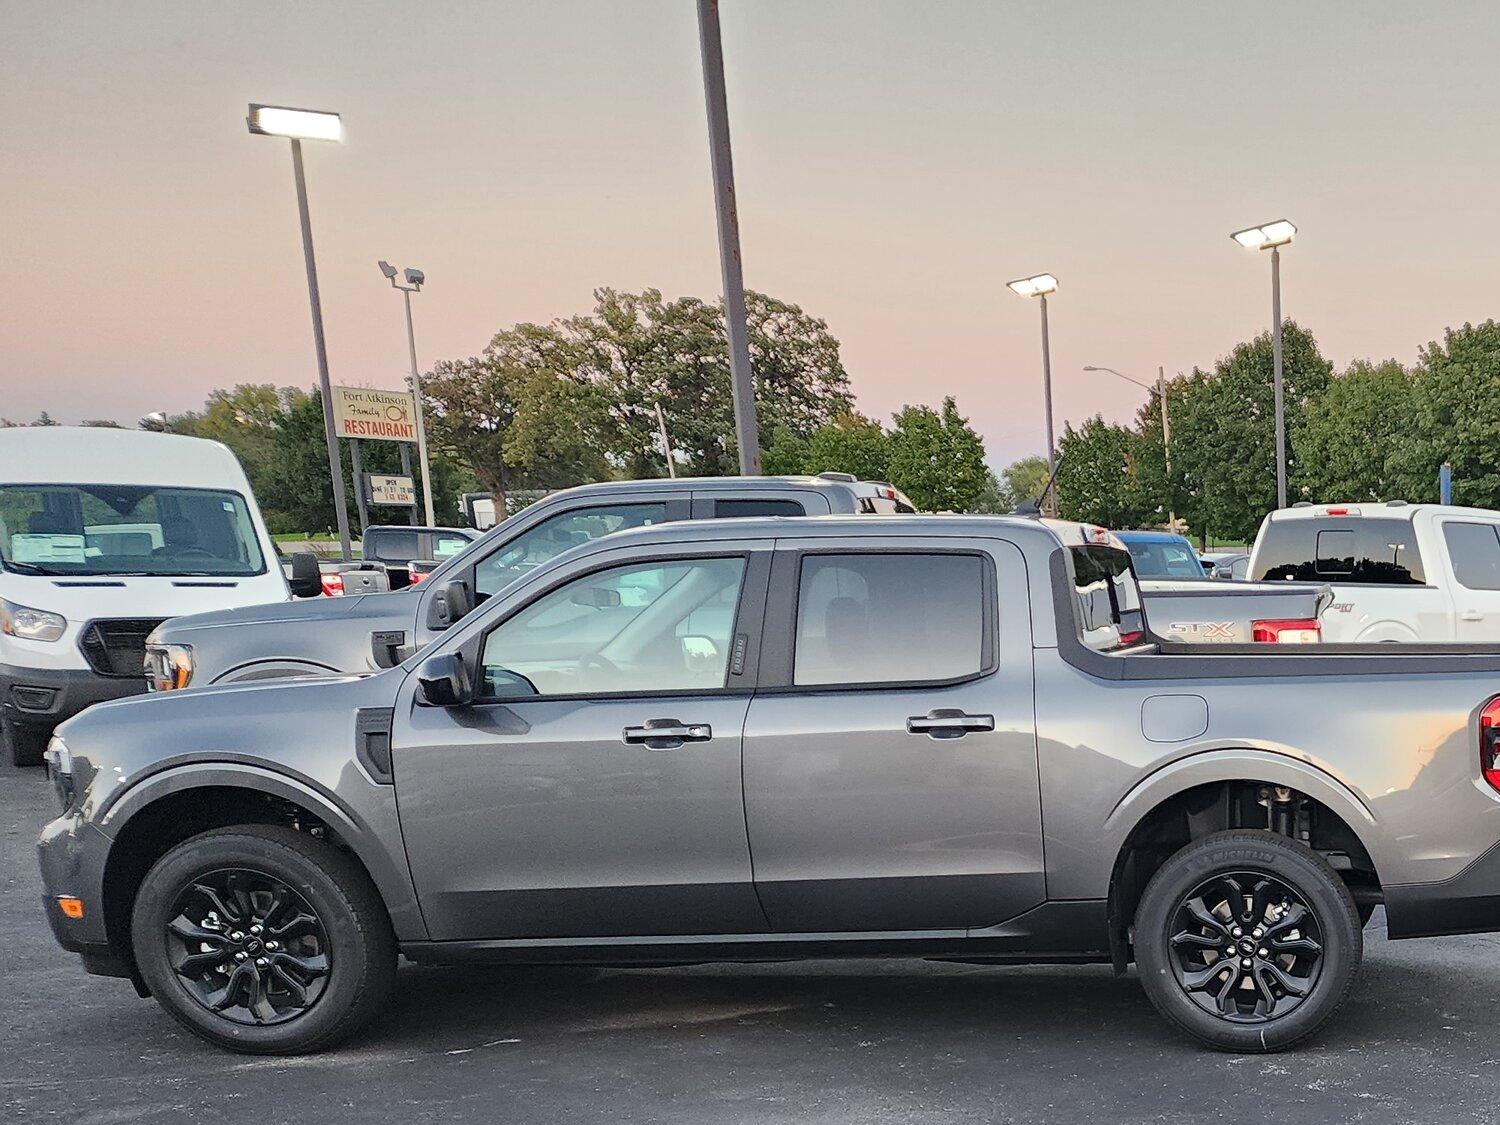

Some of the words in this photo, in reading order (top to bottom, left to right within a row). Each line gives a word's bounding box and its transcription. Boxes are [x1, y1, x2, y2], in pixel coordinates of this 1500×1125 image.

[343, 391, 362, 402] Fort
[366, 394, 408, 405] Atkinson
[348, 404, 380, 417] Family
[344, 419, 414, 438] RESTAURANT
[1168, 621, 1235, 637] STX
